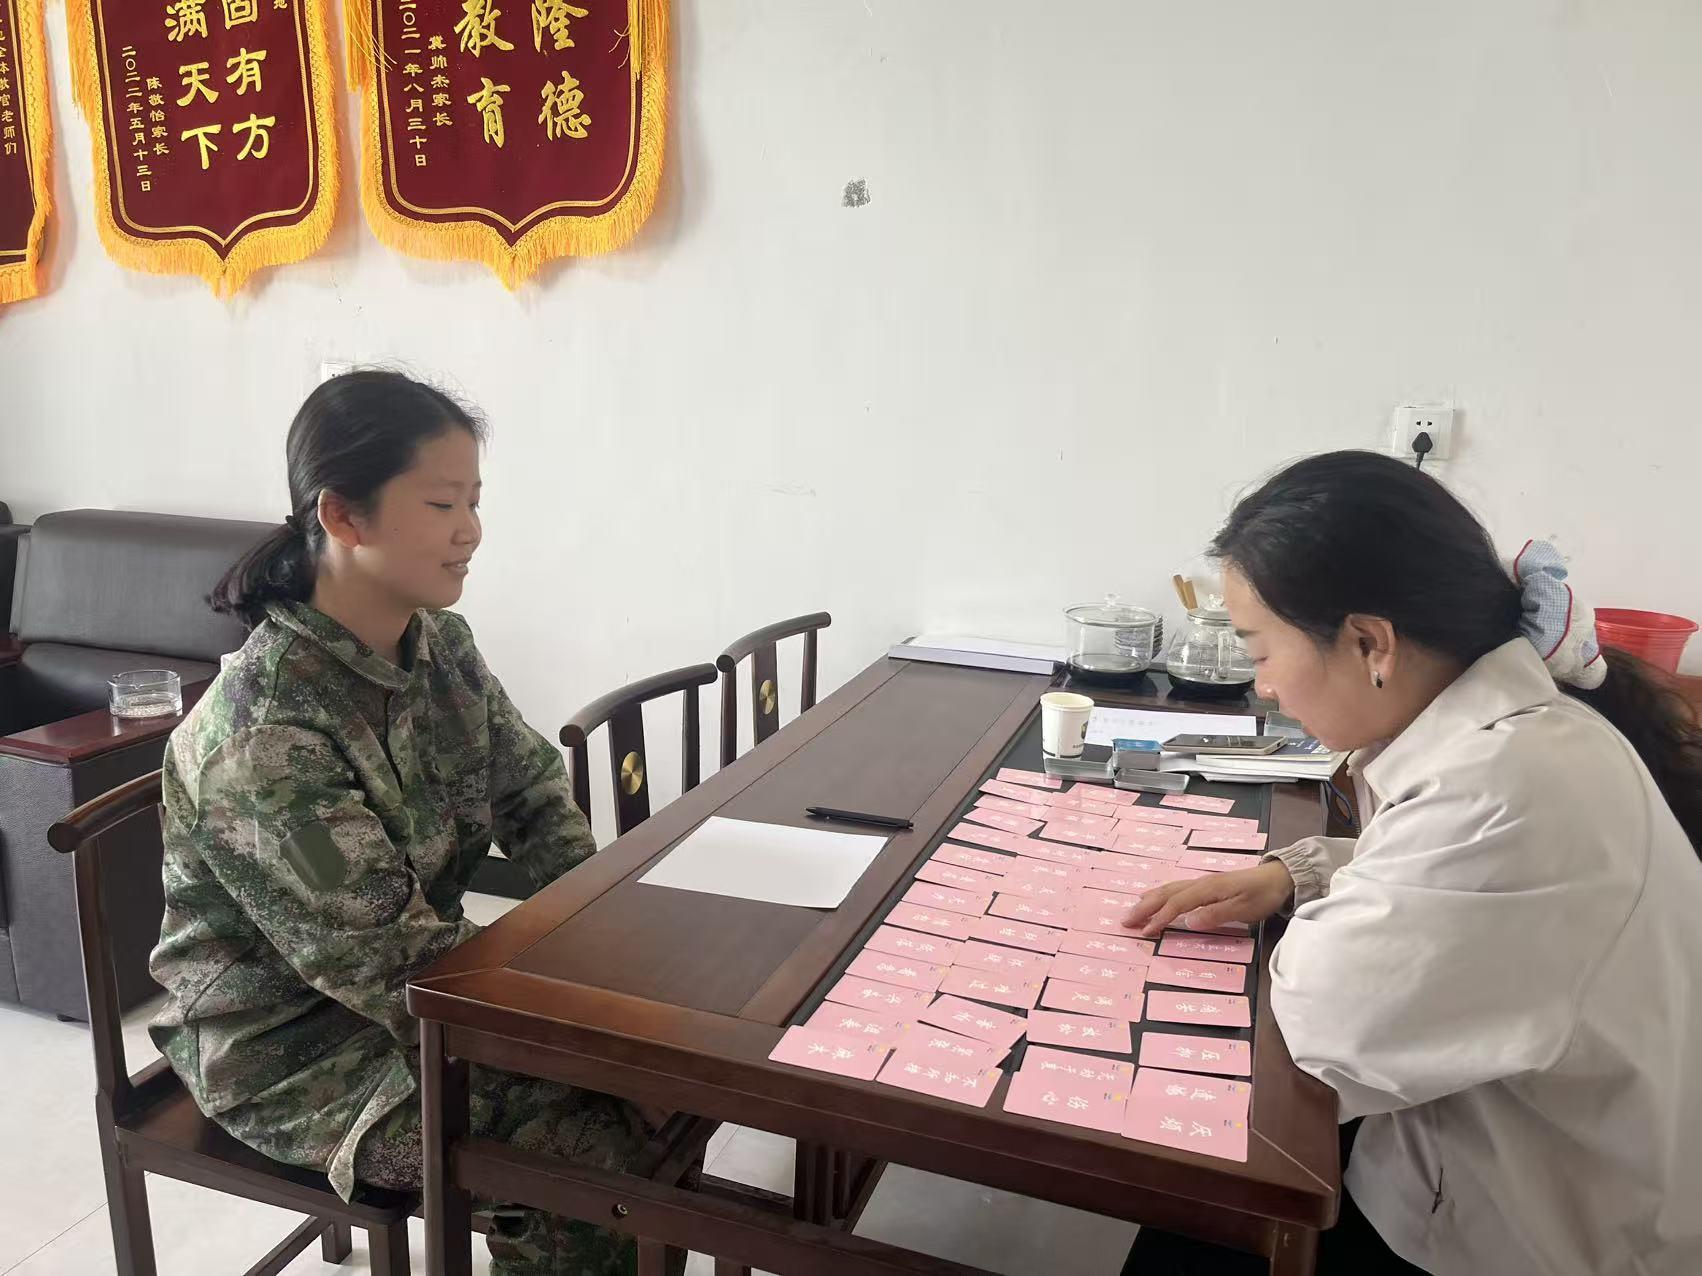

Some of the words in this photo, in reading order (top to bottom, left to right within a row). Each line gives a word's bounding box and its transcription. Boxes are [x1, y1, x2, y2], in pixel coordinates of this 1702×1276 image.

[453, 0, 515, 148] 教育
[531, 0, 592, 141] 隆德
[164, 0, 222, 170] 满天下
[398, 0, 428, 167] 二〇二一年八月三十日
[121, 45, 151, 192] 二〇二二年五月十三日
[1175, 968, 1217, 980] 自信
[969, 980, 1010, 995] 难过
[1072, 991, 1112, 1006] 满足
[1175, 1001, 1221, 1015] 痛苦
[838, 1017, 884, 1034] 沮丧
[951, 1011, 997, 1030] 害怕
[1058, 1022, 1100, 1037] 放松
[808, 1043, 854, 1060] 麻木
[904, 1063, 977, 1087] 不知所措
[1041, 1060, 1115, 1080] 无动于衷
[1042, 1092, 1088, 1110] 伤心
[1166, 1084, 1215, 1102] 遗憾
[1160, 1116, 1212, 1137] 厌烦
